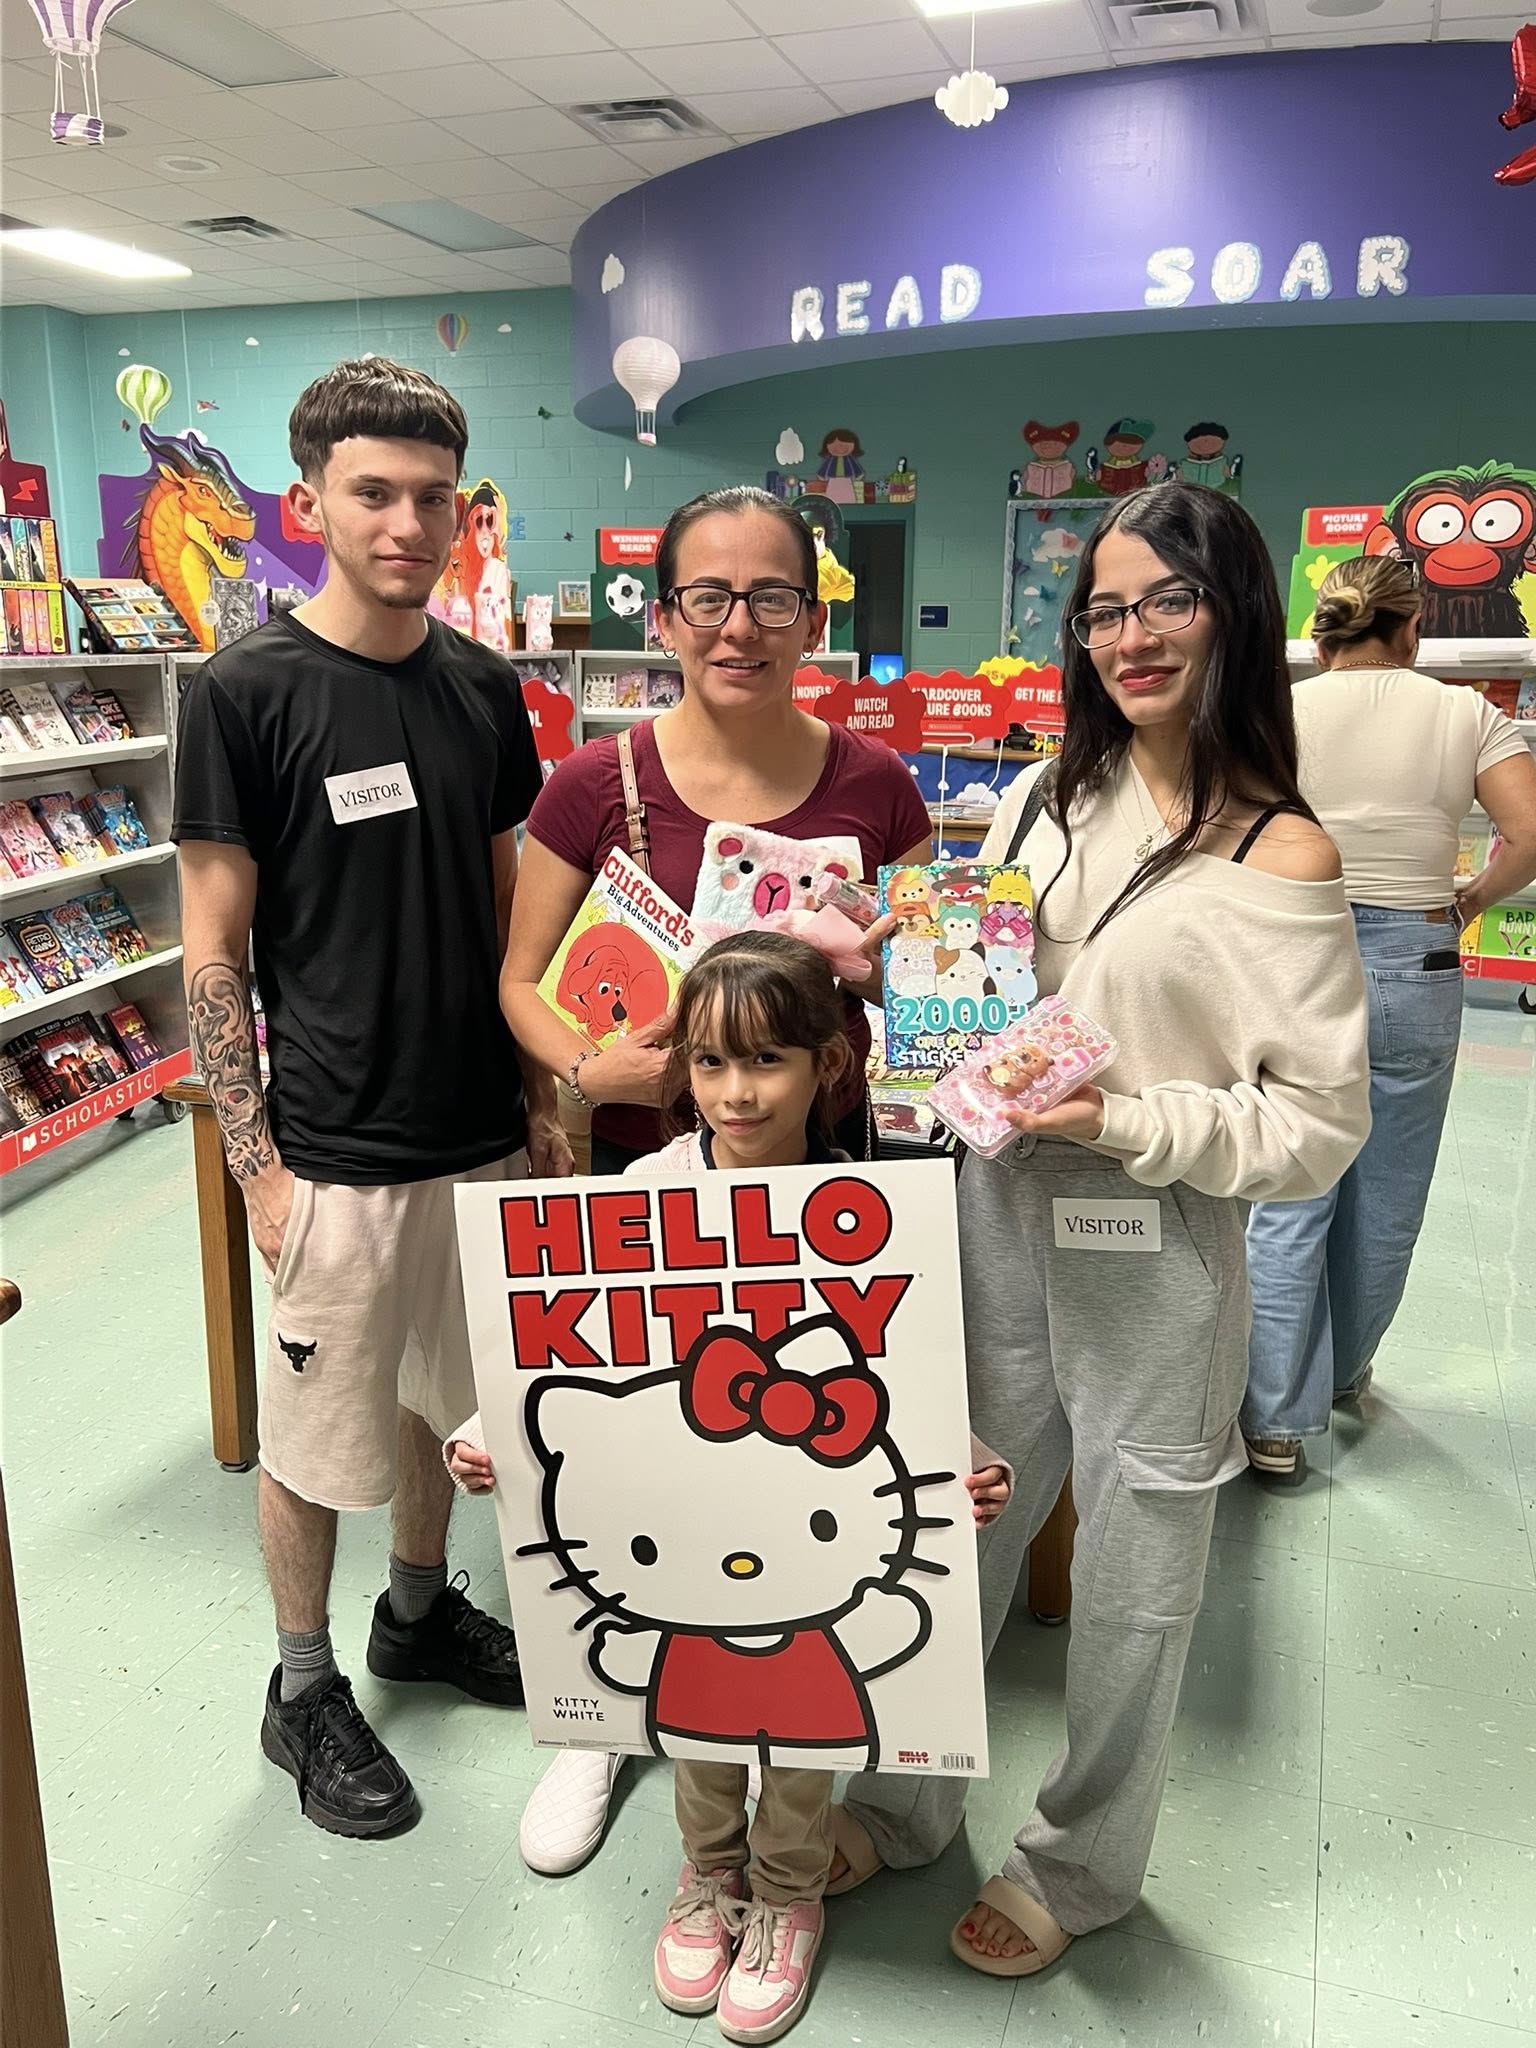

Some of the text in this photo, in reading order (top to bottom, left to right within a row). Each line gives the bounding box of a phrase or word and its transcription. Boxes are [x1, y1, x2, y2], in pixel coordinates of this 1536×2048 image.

[790, 235, 1411, 344] READ SOAR
[1322, 513, 1369, 523] PICTURE
[1325, 523, 1363, 533] BOOKS
[611, 535, 658, 544] WINNING
[619, 543, 653, 553] READS
[911, 687, 982, 703] ARDCOVER
[1015, 687, 1035, 702] GET
[1036, 688, 1056, 703] THE
[854, 697, 889, 713] WATCH
[952, 703, 993, 717] BOOKS
[846, 714, 895, 730] AND READ
[338, 782, 402, 808] VISITOR
[603, 855, 695, 947] Clifford's
[606, 883, 681, 952] Big Adventures
[1505, 911, 1536, 923] BAD
[26, 931, 52, 946] RETRO
[914, 1034, 944, 1049] ONE
[39, 1073, 154, 1144] SCHOLASTIC
[500, 1176, 893, 1278] HELLO
[1064, 1216, 1146, 1236] VISITOR
[508, 1273, 914, 1369] KITTY
[554, 1697, 599, 1709] KITTY
[553, 1709, 605, 1722] WHITE
[898, 1750, 929, 1758] HELLO
